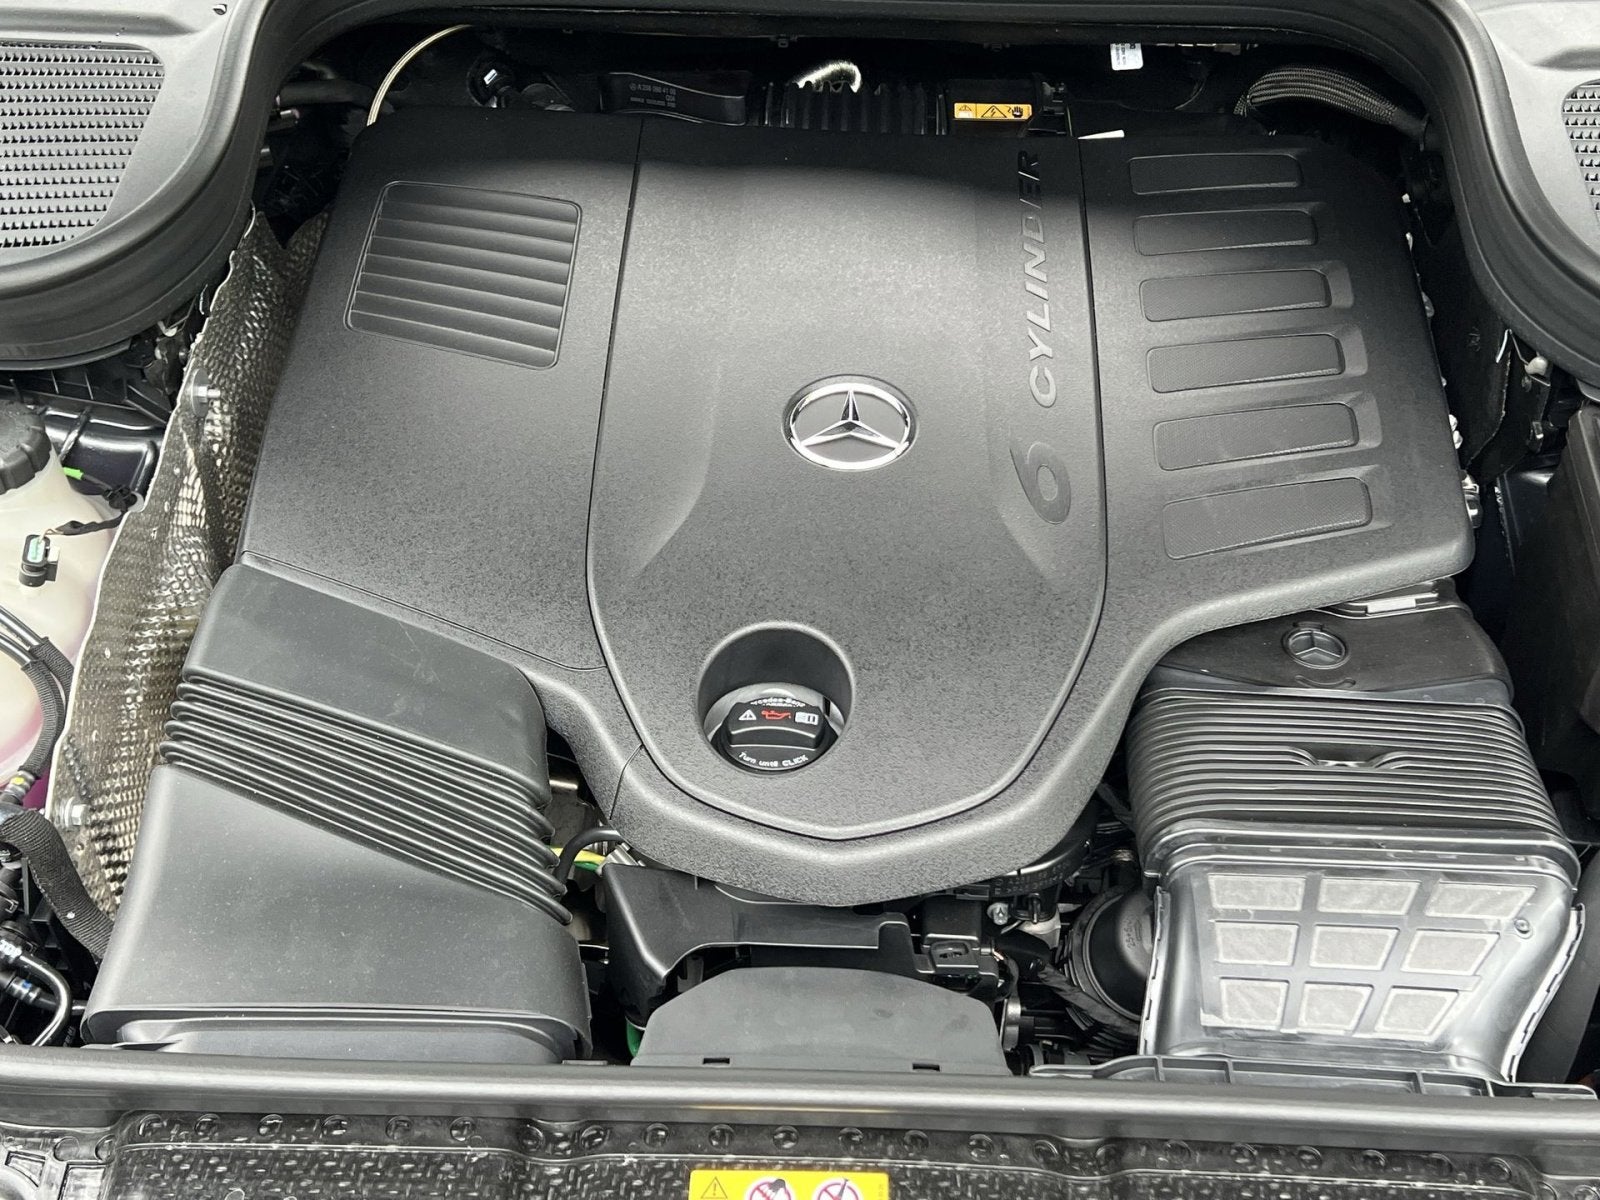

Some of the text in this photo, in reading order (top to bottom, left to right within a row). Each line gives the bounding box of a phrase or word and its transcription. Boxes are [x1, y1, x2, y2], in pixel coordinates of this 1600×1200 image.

[1009, 151, 1072, 525] 6 CYLINDER
[738, 751, 757, 764] Turn
[781, 754, 808, 767] CLICK
